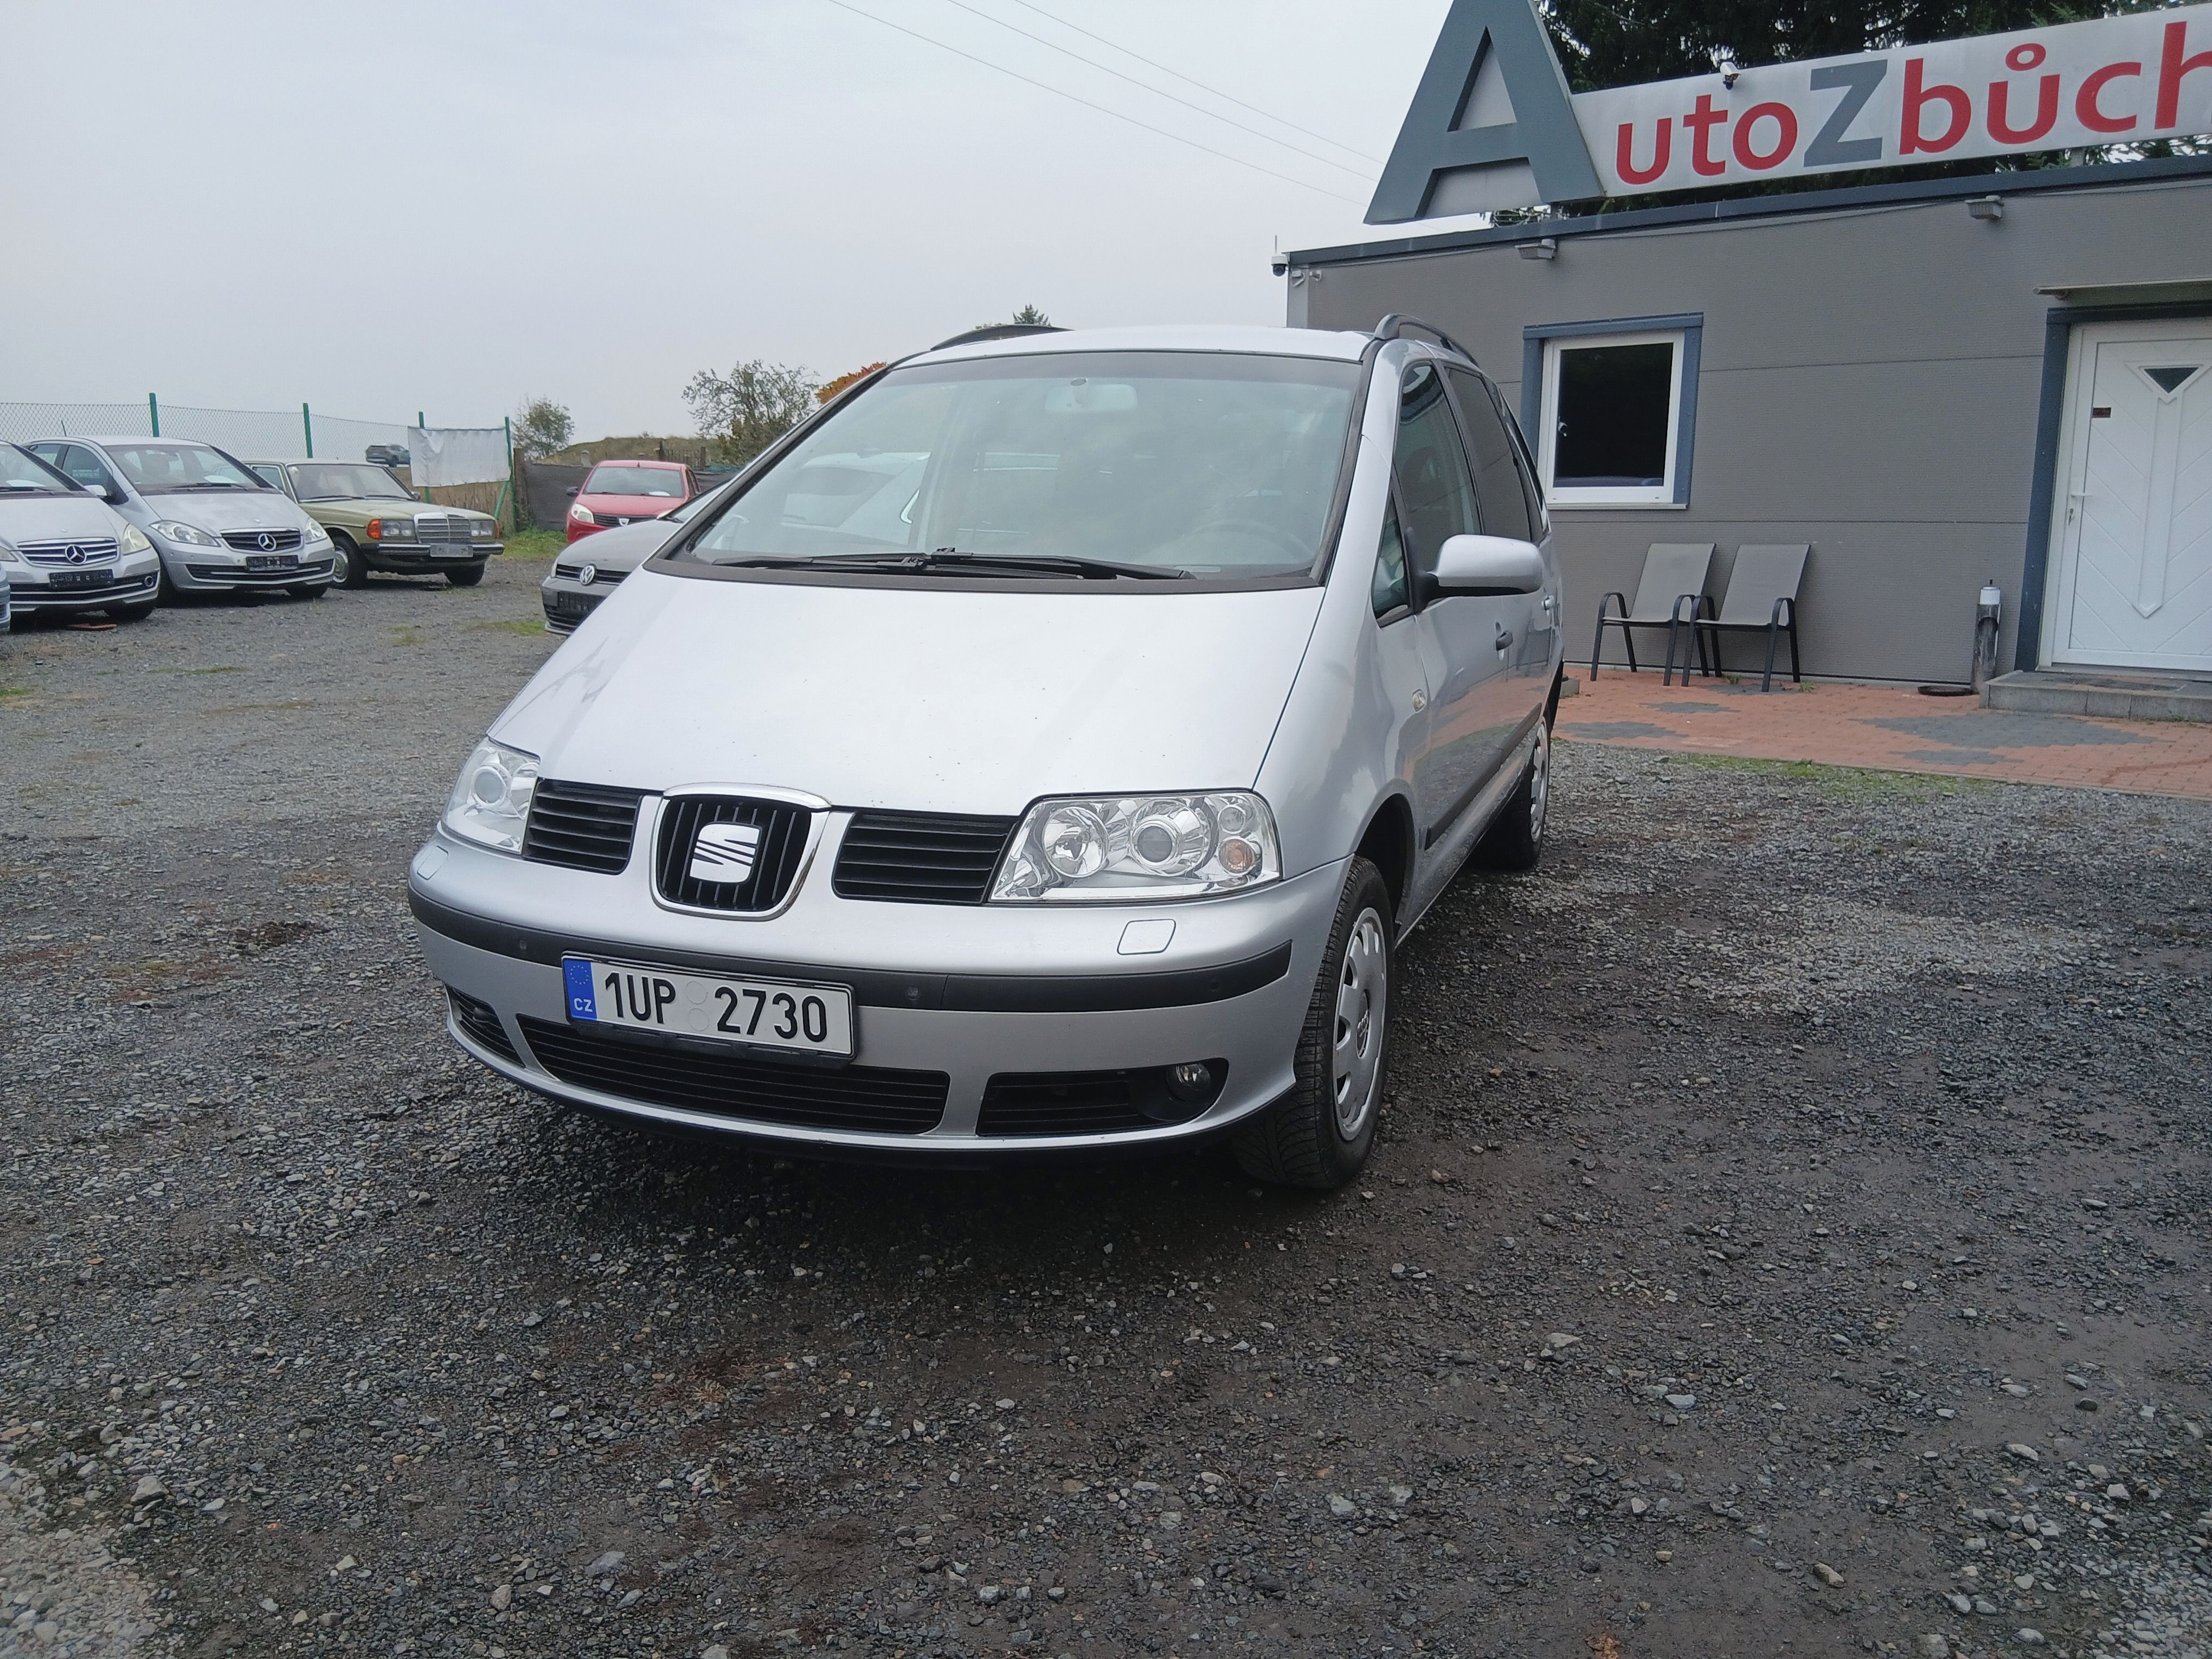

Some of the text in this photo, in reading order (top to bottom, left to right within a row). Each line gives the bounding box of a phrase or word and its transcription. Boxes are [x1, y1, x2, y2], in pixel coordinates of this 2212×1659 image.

[573, 970, 828, 1043] CZ 1UP 2730
